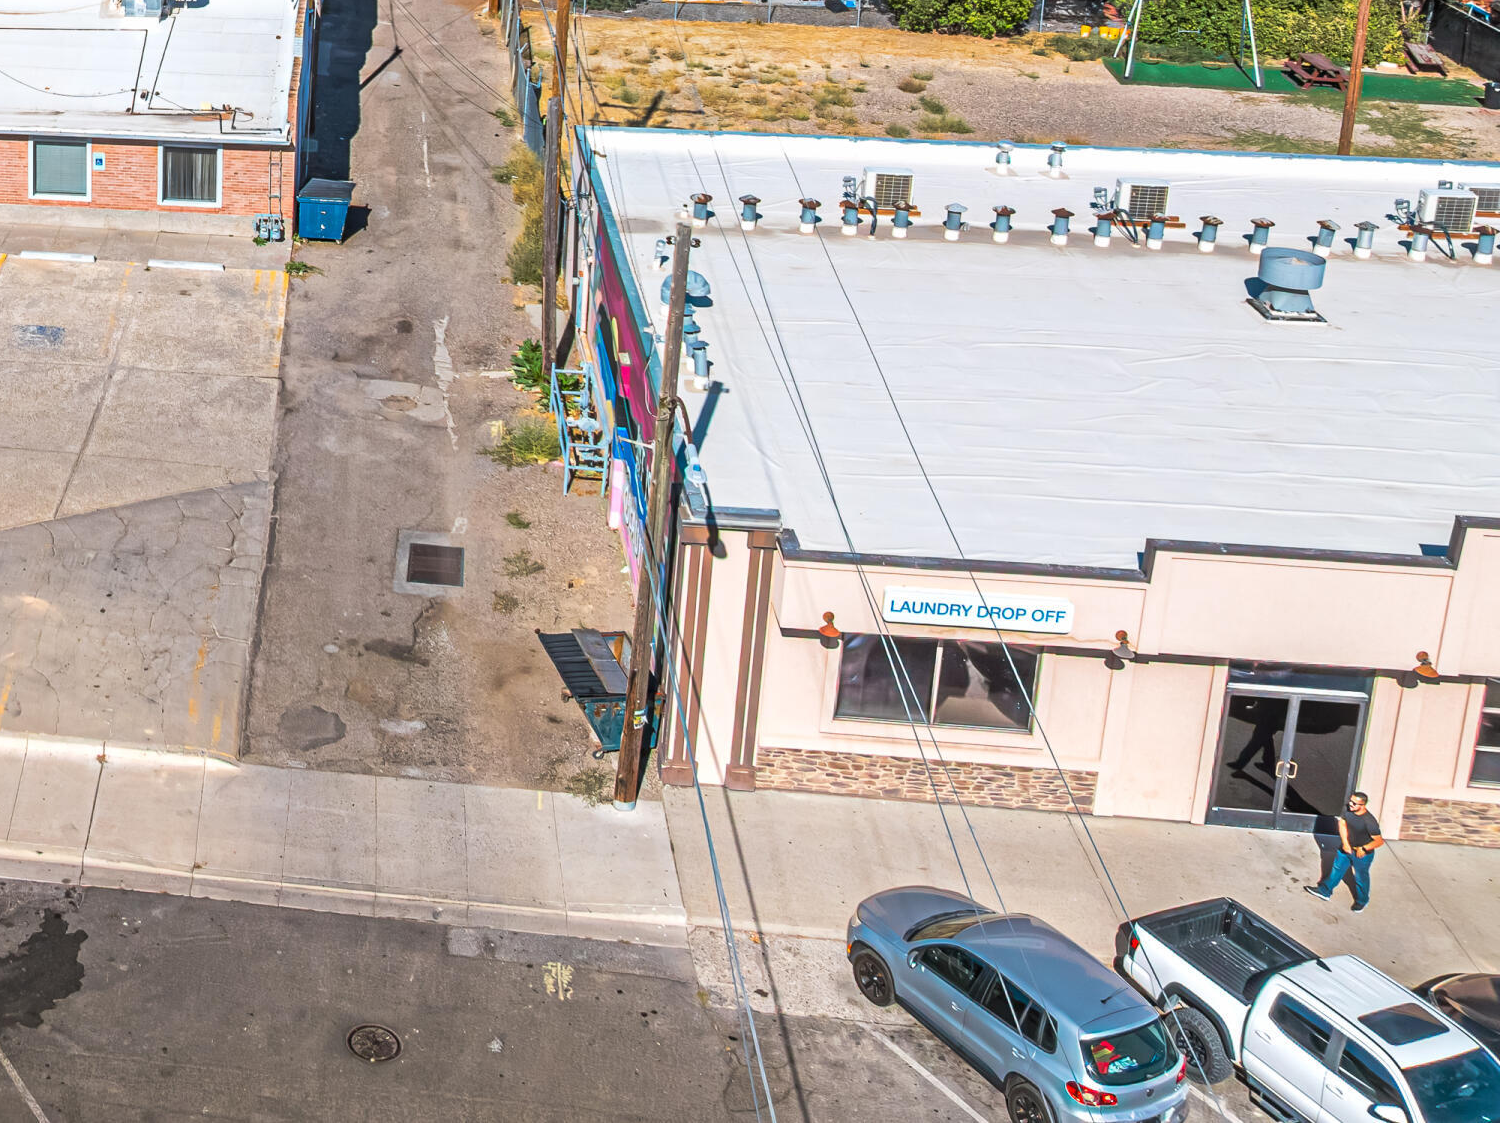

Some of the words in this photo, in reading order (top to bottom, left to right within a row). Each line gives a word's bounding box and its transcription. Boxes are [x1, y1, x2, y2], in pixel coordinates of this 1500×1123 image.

[890, 599, 973, 617] LAUNDRY
[976, 605, 1027, 621] DROP
[1031, 609, 1066, 623] OFF
